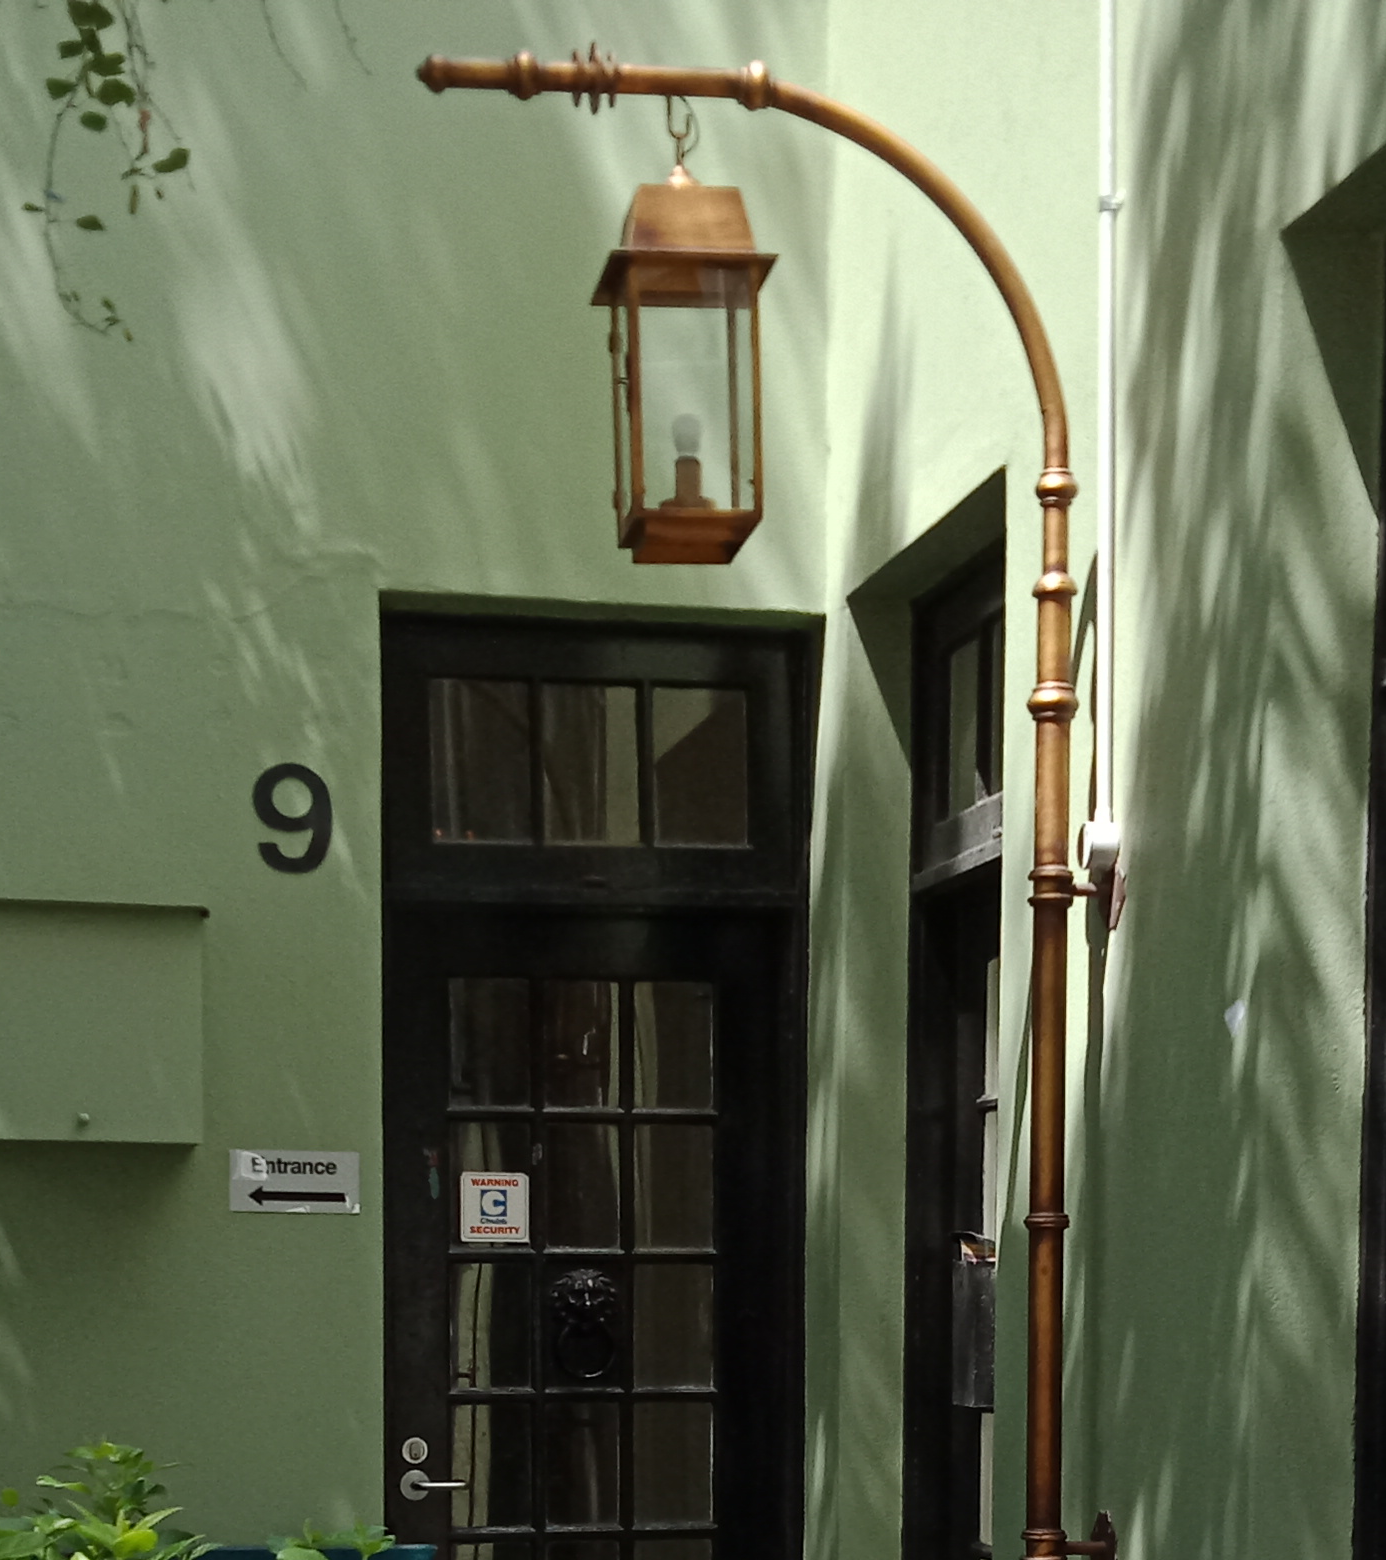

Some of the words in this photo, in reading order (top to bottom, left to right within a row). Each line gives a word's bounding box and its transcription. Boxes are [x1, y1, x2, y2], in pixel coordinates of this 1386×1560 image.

[252, 762, 333, 874] 9
[251, 1157, 337, 1175] Entrance
[471, 1178, 519, 1187] WARNING
[469, 1226, 520, 1235] SECURITY
